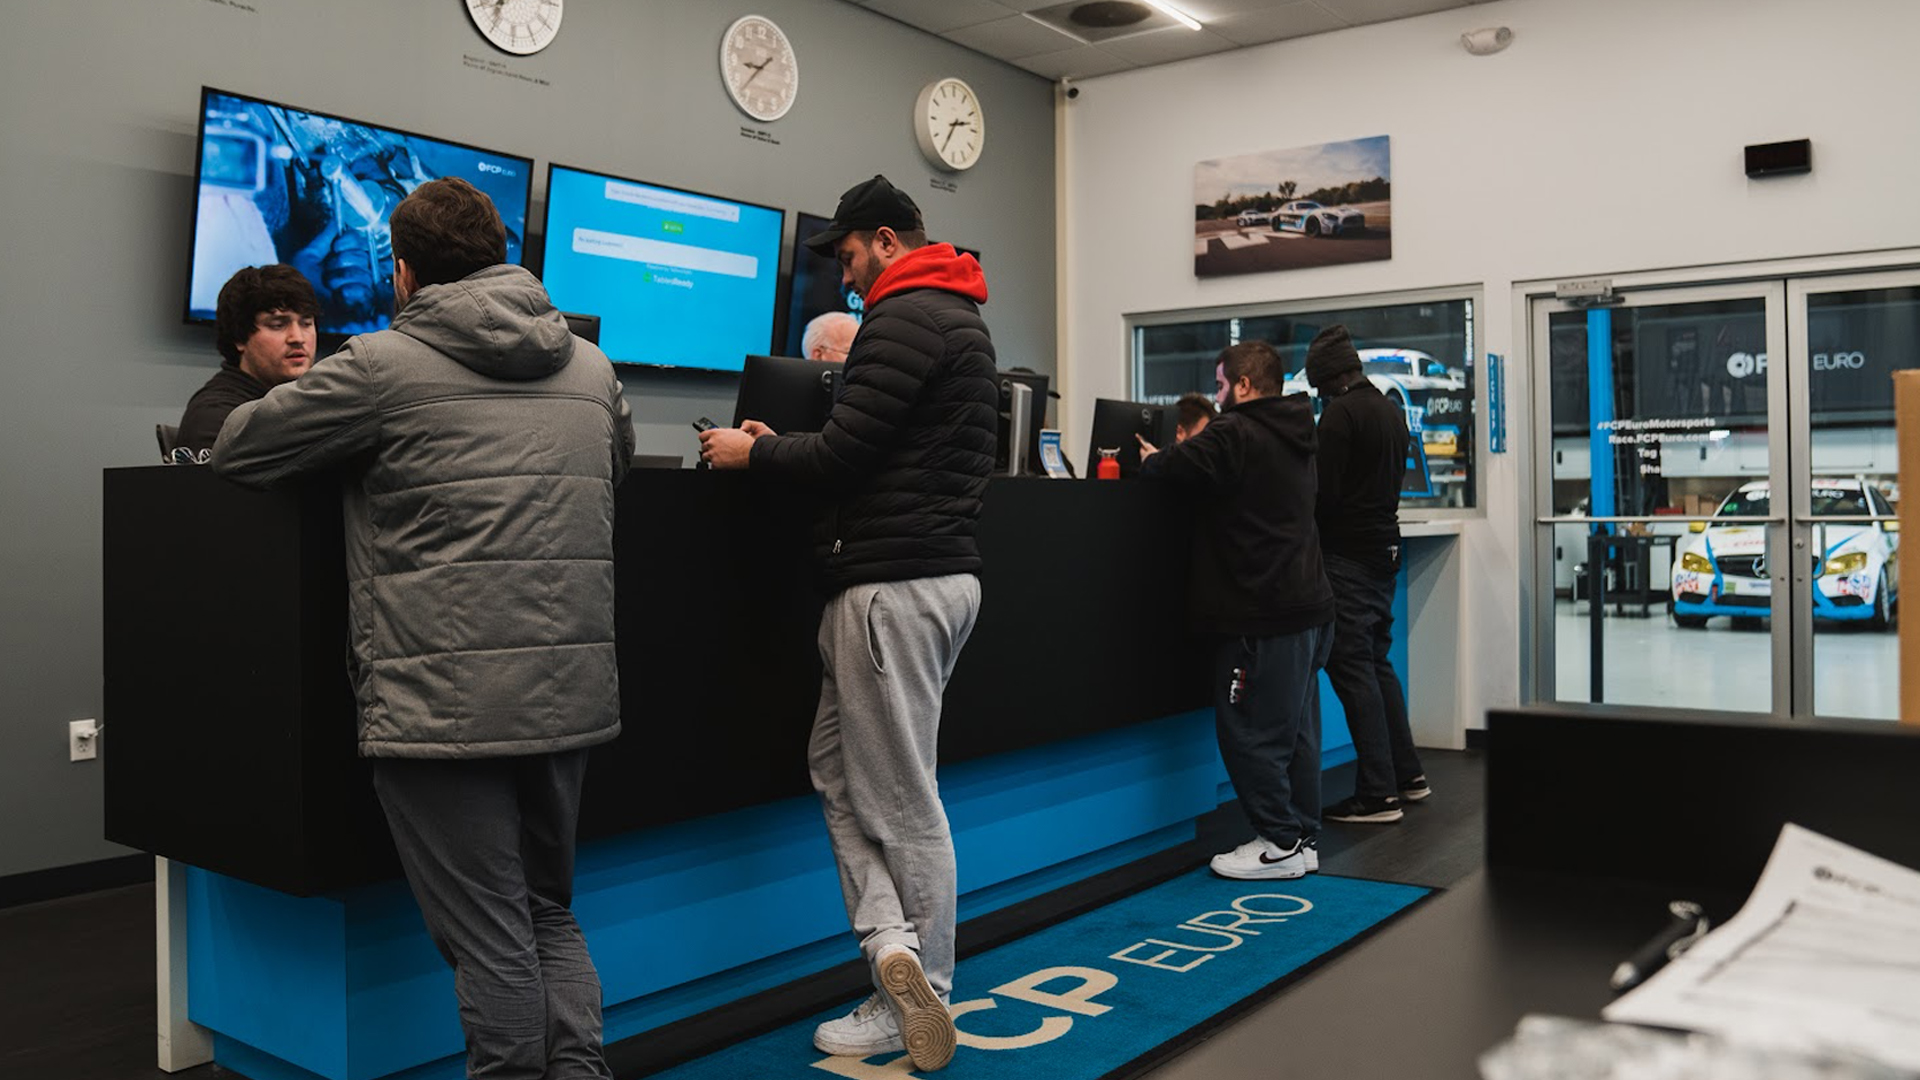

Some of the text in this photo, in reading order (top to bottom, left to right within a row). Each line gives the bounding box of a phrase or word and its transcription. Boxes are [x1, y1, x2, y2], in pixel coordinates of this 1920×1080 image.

[1813, 351, 1865, 370] EURO
[1434, 397, 1449, 414] FCP
[1597, 418, 1716, 430] #FCPEuroMotorsports
[1637, 448, 1658, 459] Tag
[1640, 464, 1664, 474] Sha
[1107, 893, 1315, 973] EURO
